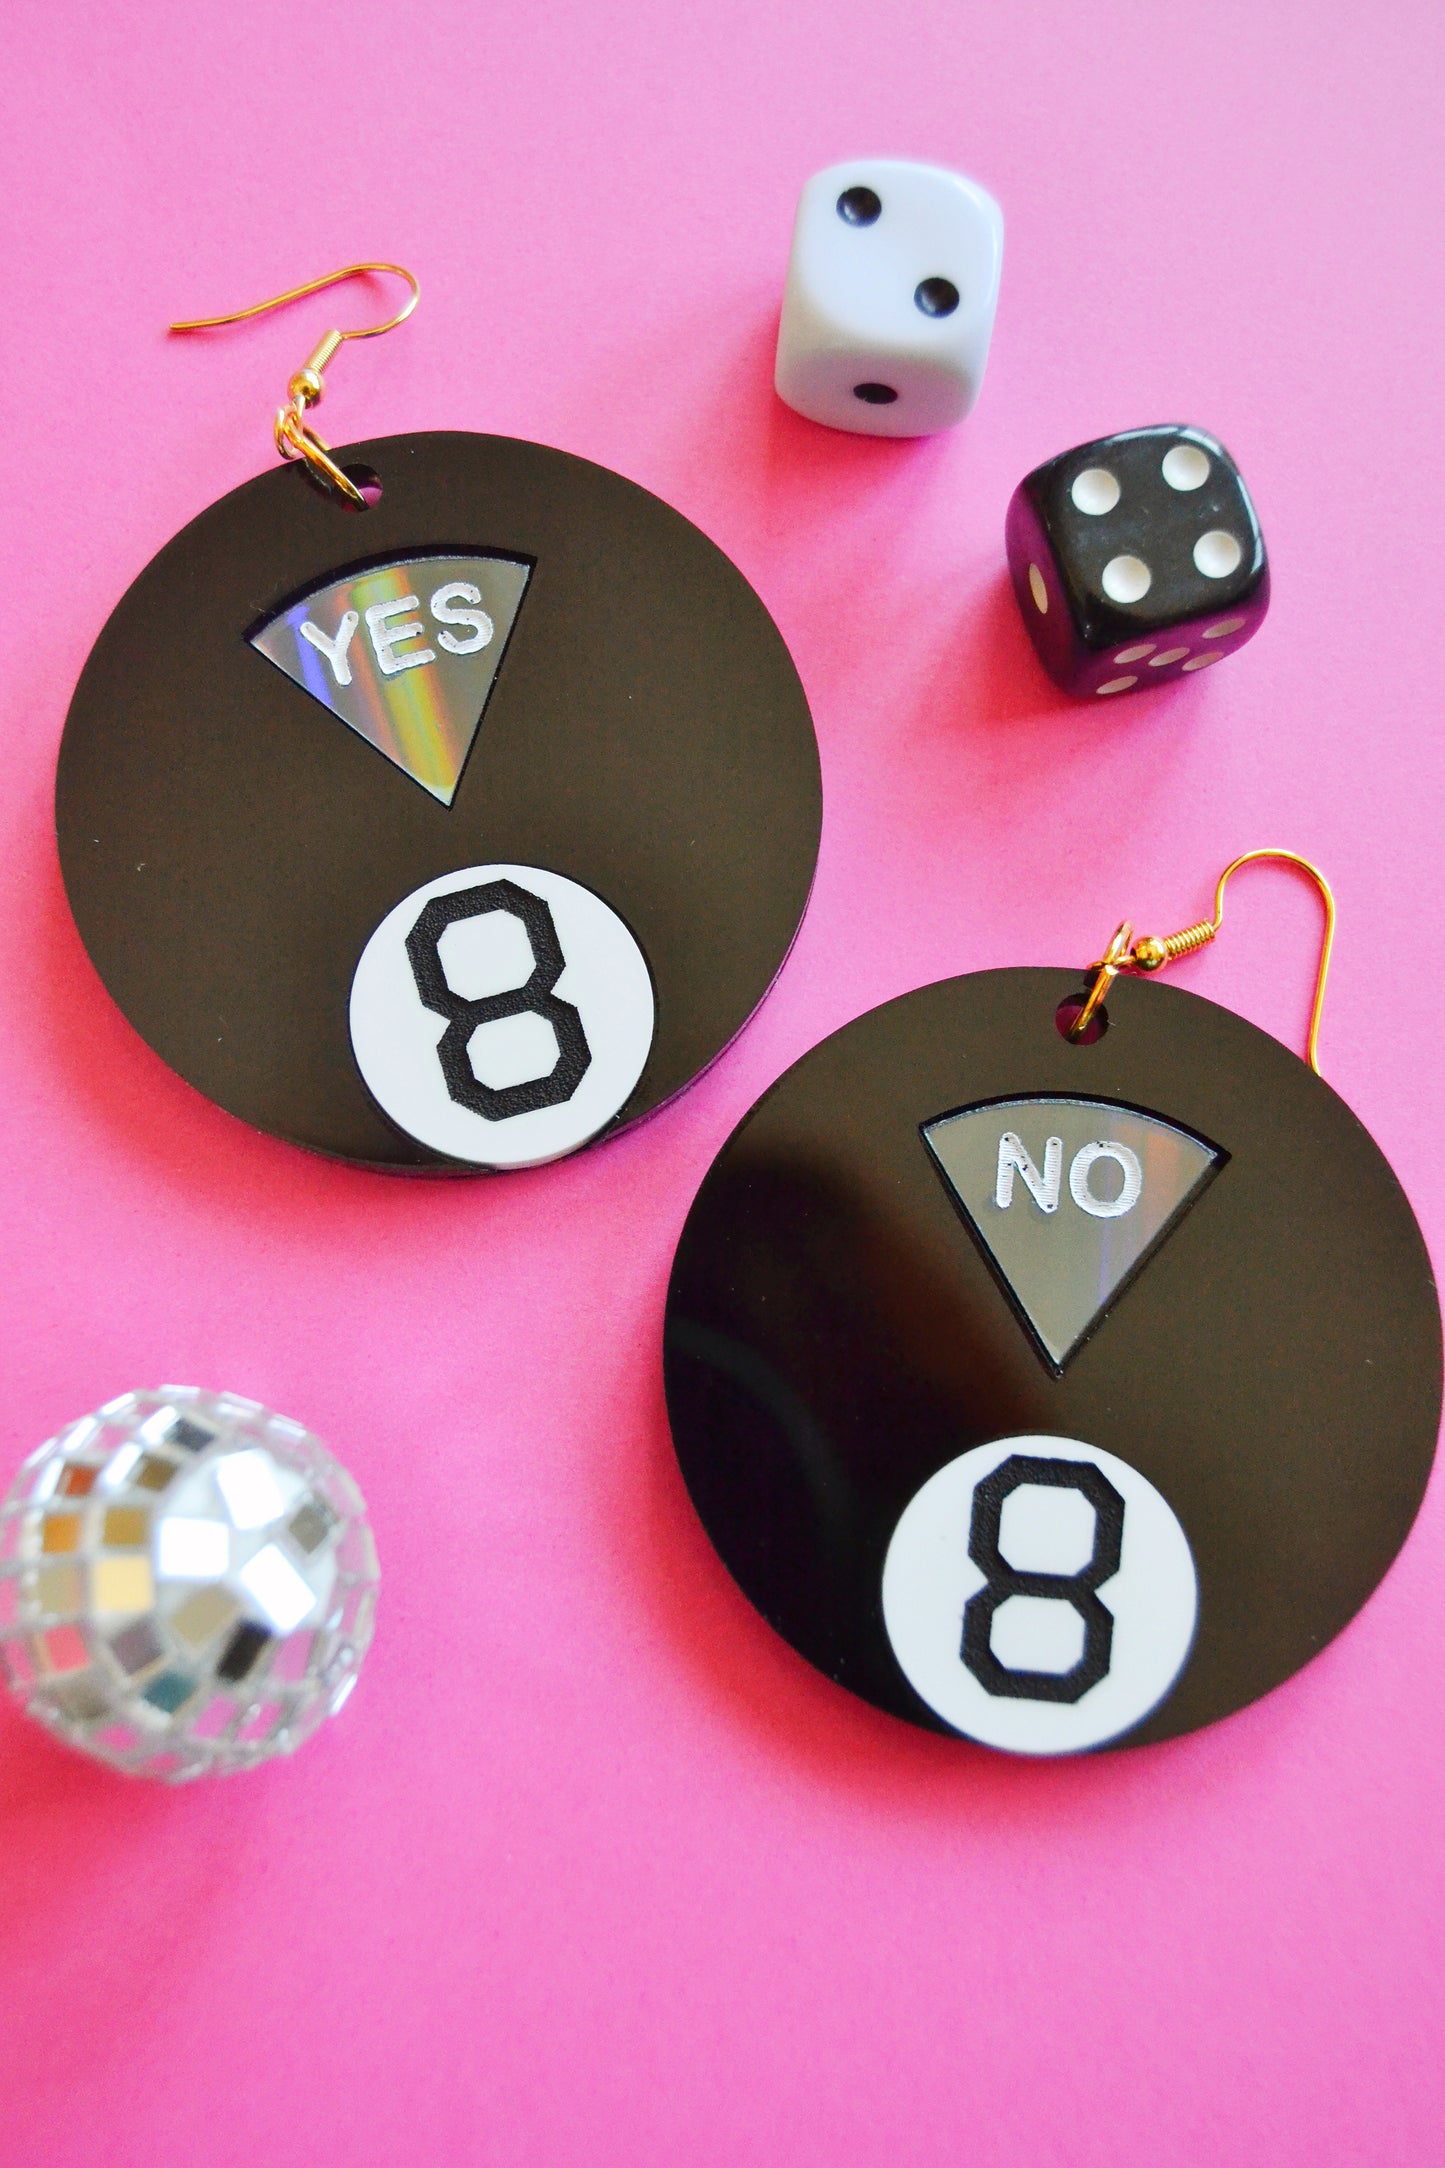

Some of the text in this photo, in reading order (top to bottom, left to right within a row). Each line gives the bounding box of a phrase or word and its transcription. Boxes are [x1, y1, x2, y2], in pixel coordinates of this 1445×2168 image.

[300, 580, 496, 687] YES
[405, 878, 592, 1122] 8
[994, 1131, 1143, 1219] NO
[959, 1453, 1127, 1704] 8
